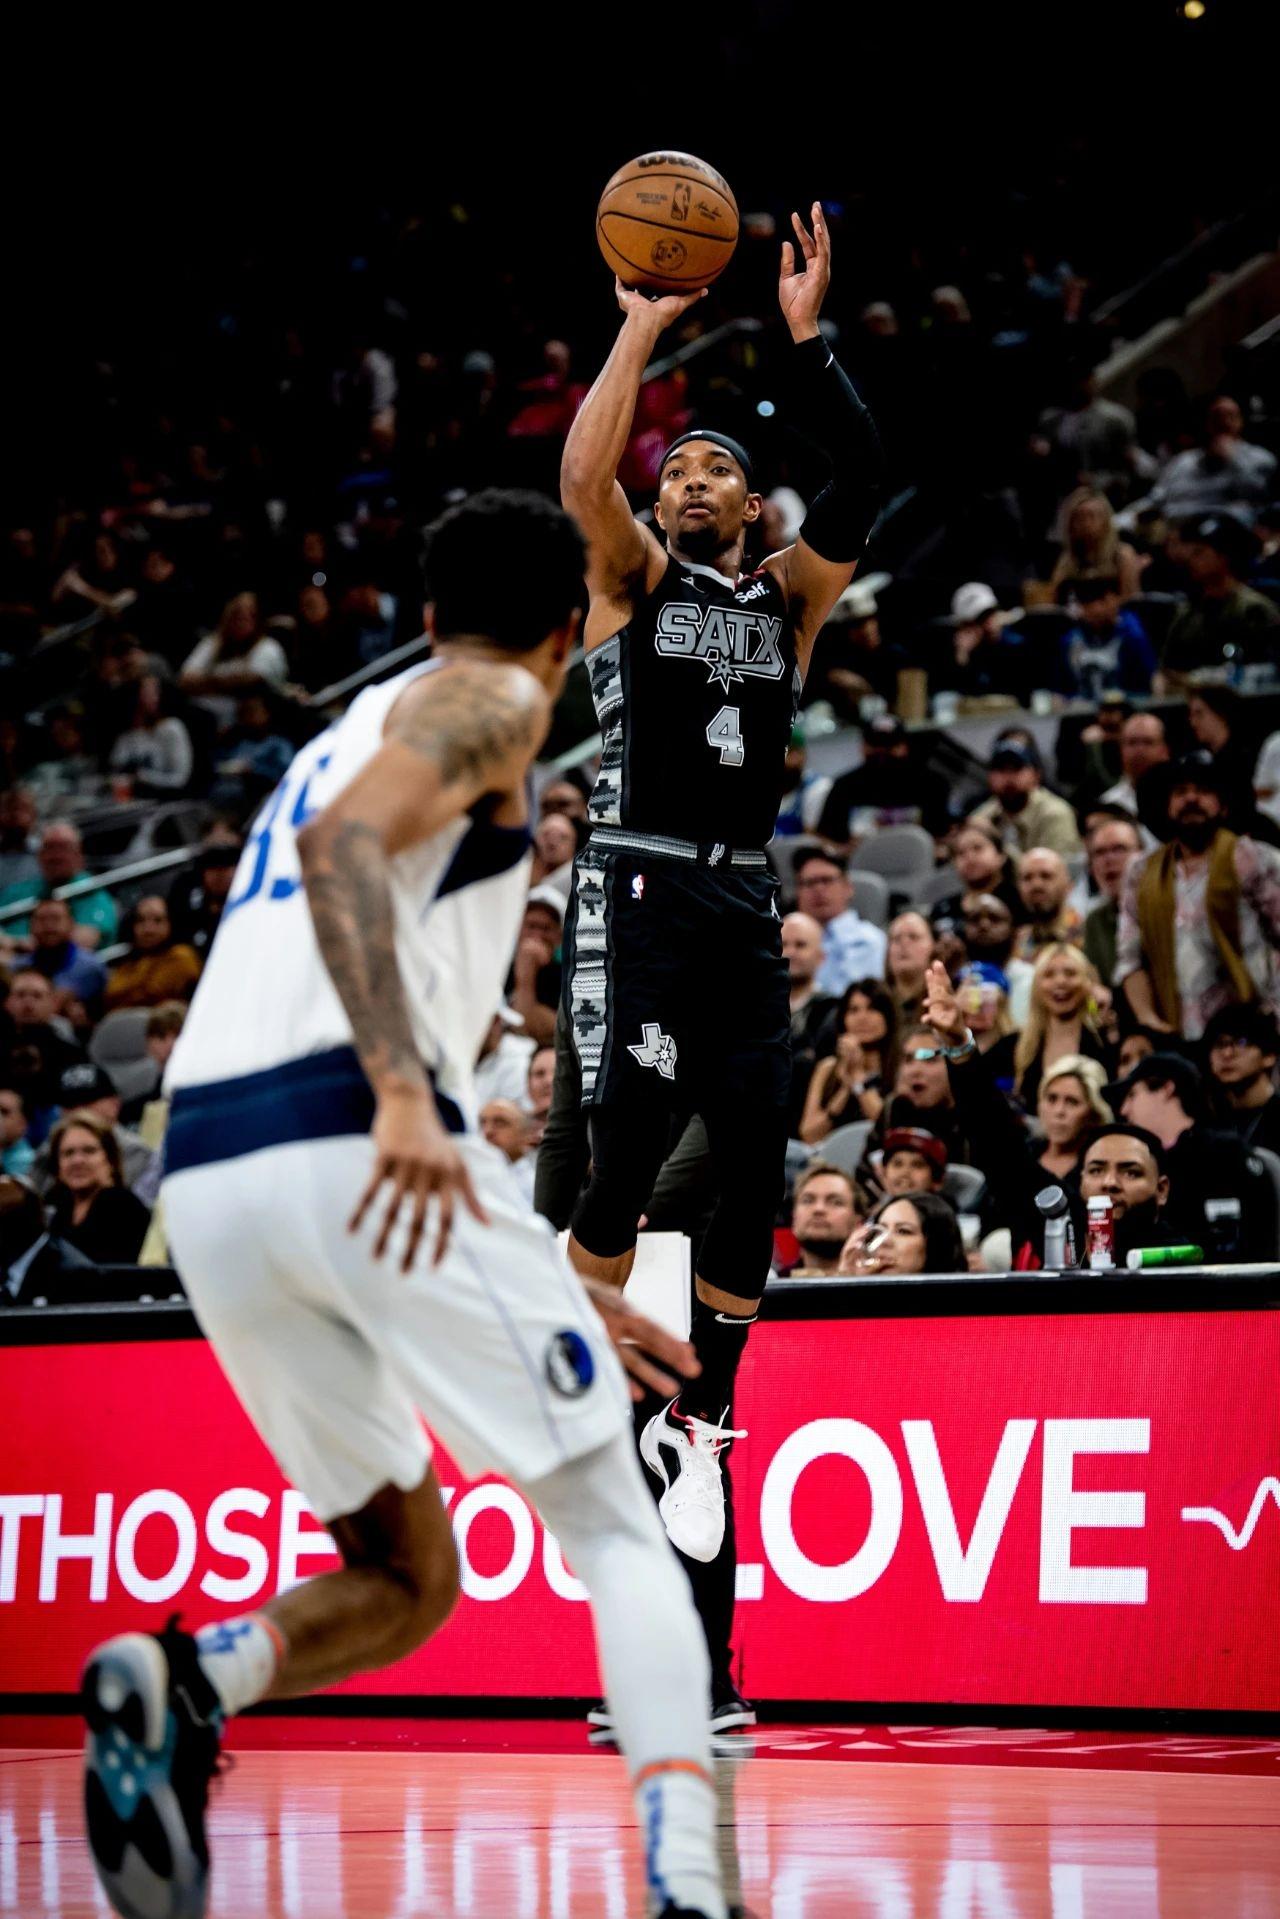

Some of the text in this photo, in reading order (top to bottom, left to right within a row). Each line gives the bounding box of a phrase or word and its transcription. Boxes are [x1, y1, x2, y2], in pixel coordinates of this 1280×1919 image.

[655, 602, 785, 681] SATX
[706, 705, 745, 767] 4
[735, 1417, 1151, 1604] OVE
